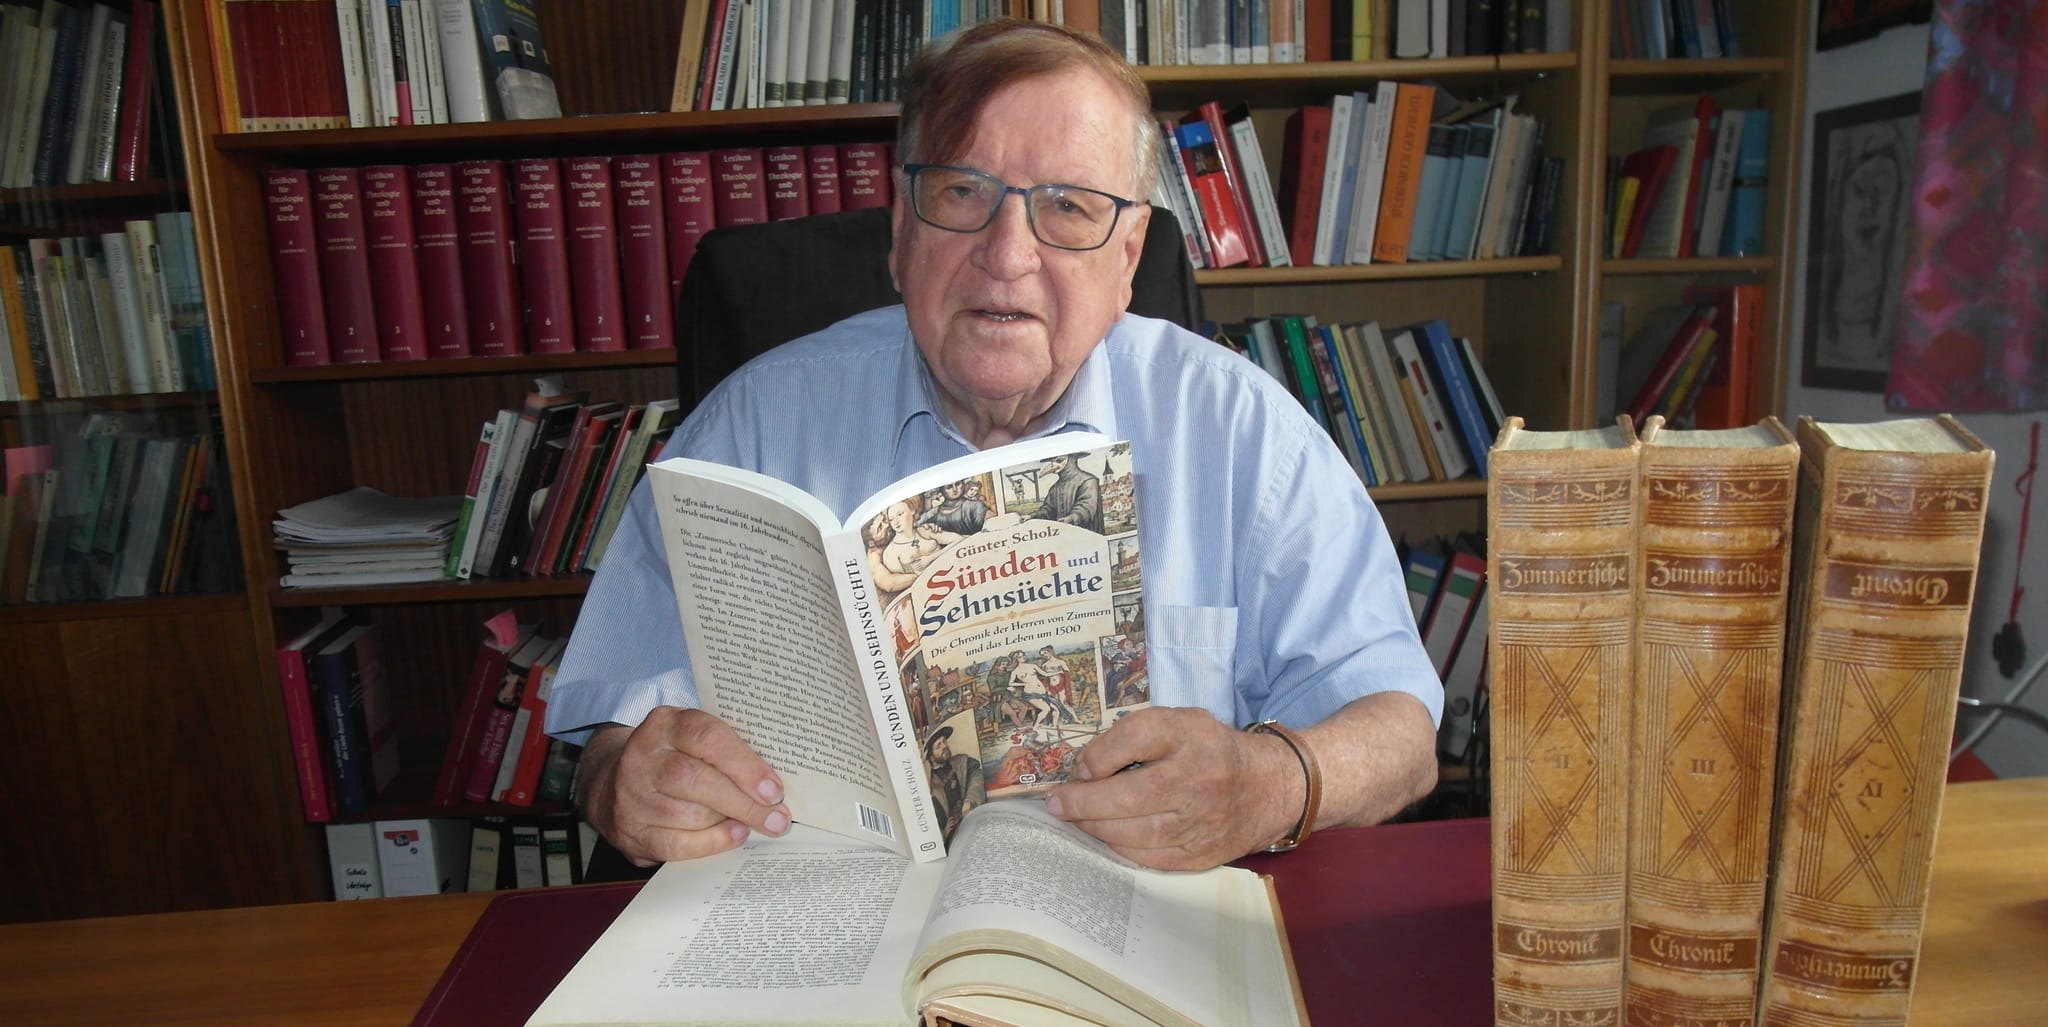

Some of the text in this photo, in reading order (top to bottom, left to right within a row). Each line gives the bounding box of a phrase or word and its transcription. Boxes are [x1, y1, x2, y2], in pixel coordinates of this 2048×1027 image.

[489, 322, 495, 331] 5
[545, 316, 552, 326] 6
[597, 315, 604, 325] 7
[645, 313, 652, 323] 8
[299, 329, 305, 338] 1
[348, 327, 354, 336] 2
[395, 325, 401, 334] 3
[682, 498, 698, 507] offen
[716, 505, 749, 519] Sexualität
[750, 515, 762, 524] und
[699, 513, 728, 524] niemand
[740, 522, 750, 530] 16.
[750, 525, 789, 545] Jahrhundert
[955, 526, 1060, 560] Günter Scholz
[926, 548, 1099, 602] Sünden und
[920, 571, 1104, 639] Sehnsüchte
[930, 607, 1112, 659] Die Chronik der Herren von Zimmern
[965, 623, 1082, 657] und das Leben um 1500
[845, 558, 906, 748] SÜNDEN UND SEHNSÜCHTE
[1690, 758, 1716, 775] III
[1861, 782, 1885, 799] IV
